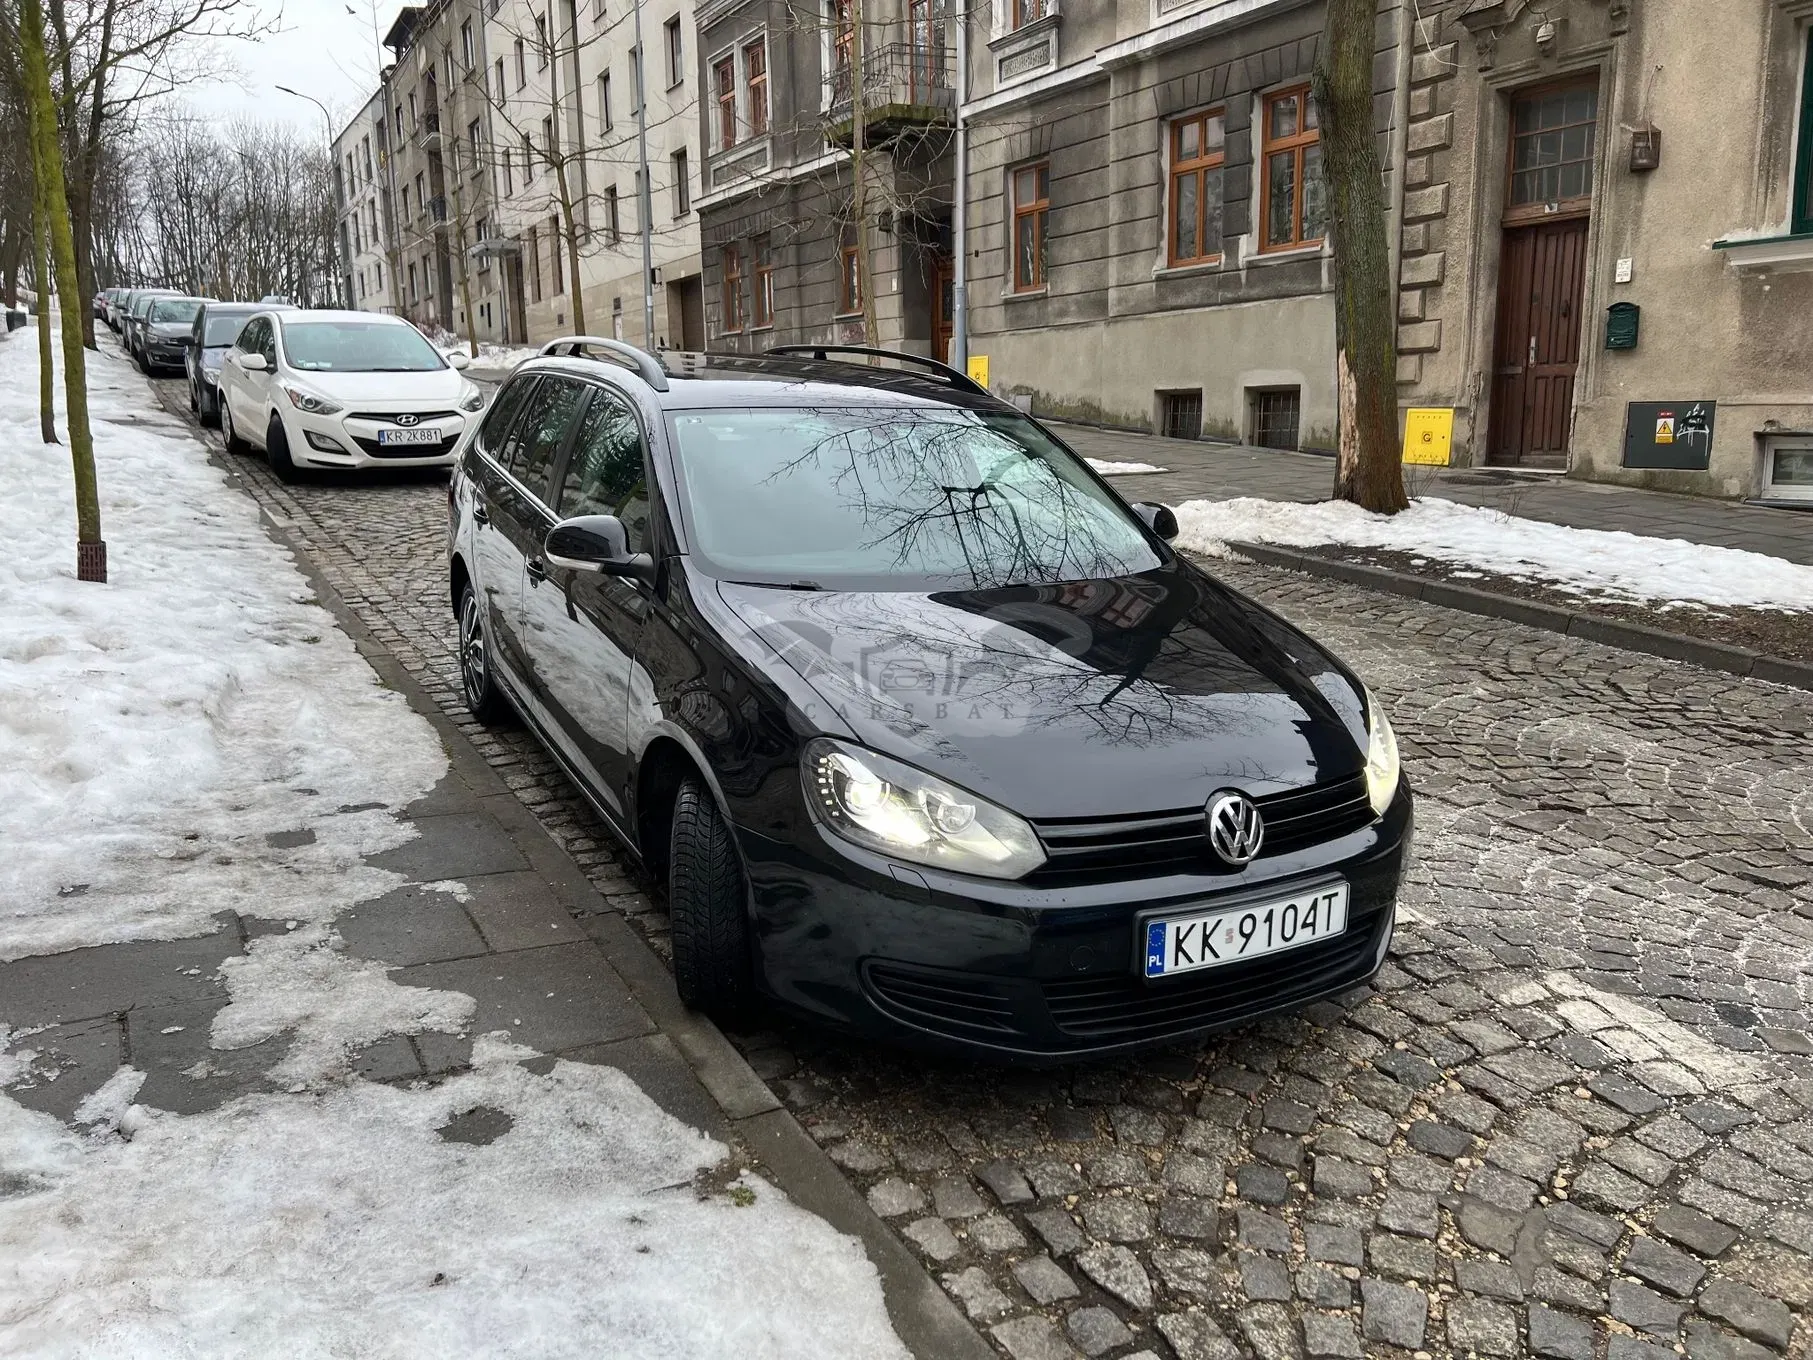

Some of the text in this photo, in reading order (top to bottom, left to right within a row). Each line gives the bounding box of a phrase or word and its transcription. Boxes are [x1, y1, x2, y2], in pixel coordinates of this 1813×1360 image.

[386, 430, 437, 442] KR 2K881
[1174, 892, 1339, 966] KK 9104T
[1149, 955, 1162, 967] PL
